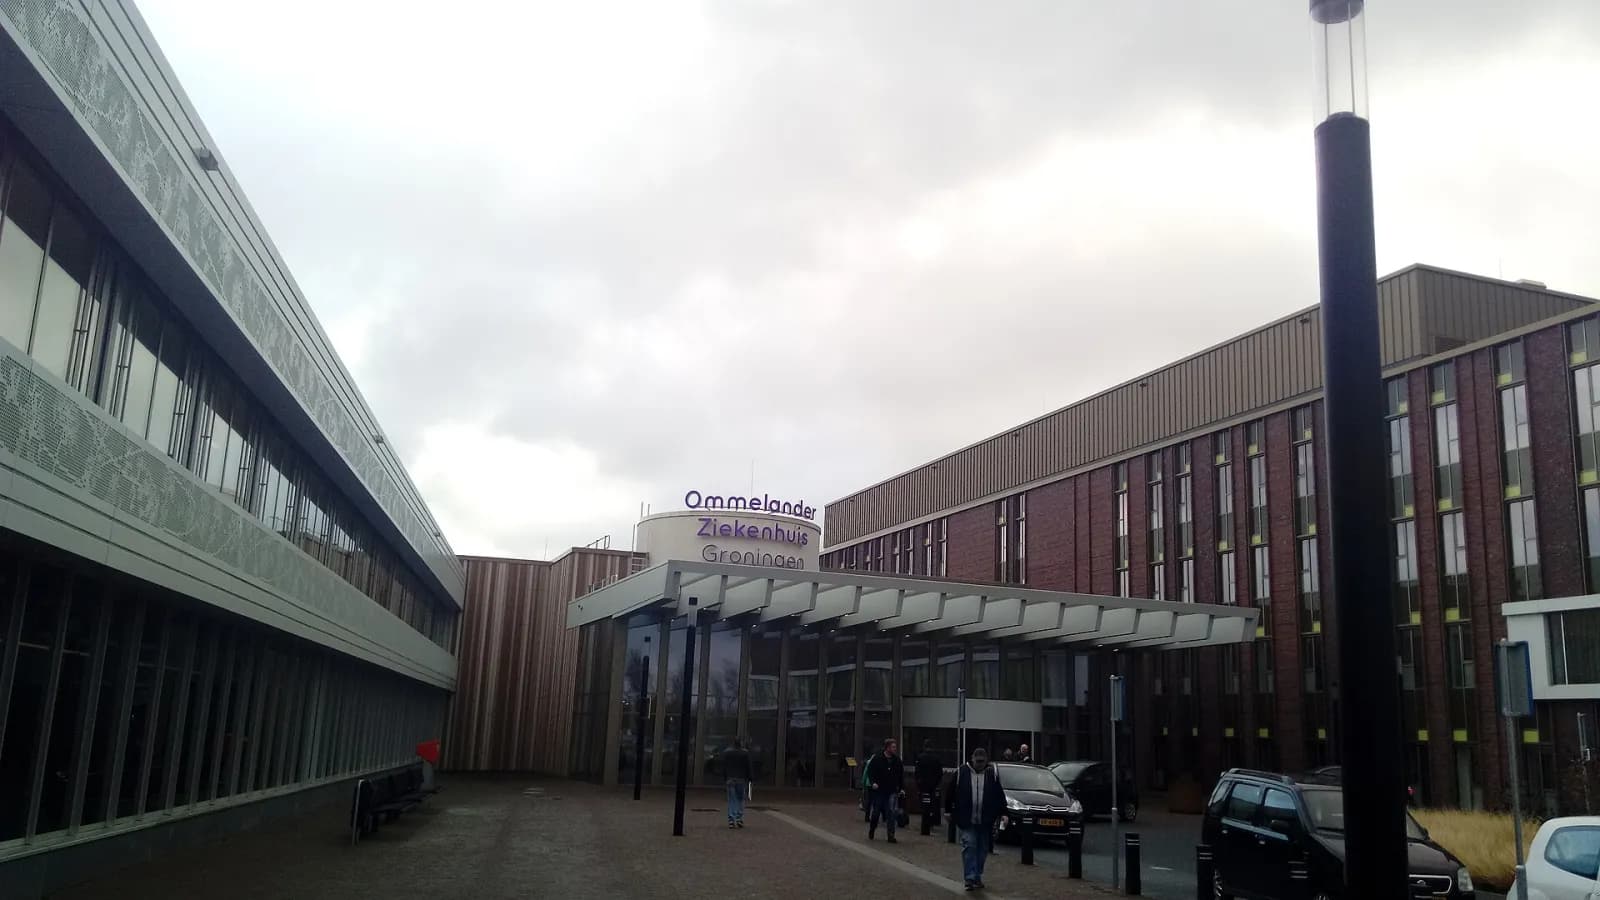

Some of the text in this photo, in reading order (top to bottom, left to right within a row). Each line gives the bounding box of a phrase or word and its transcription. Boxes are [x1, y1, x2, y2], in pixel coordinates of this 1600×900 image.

[685, 490, 817, 520] Ommelander
[697, 518, 808, 545] Ziekenhuis
[702, 544, 804, 570] Groningen
